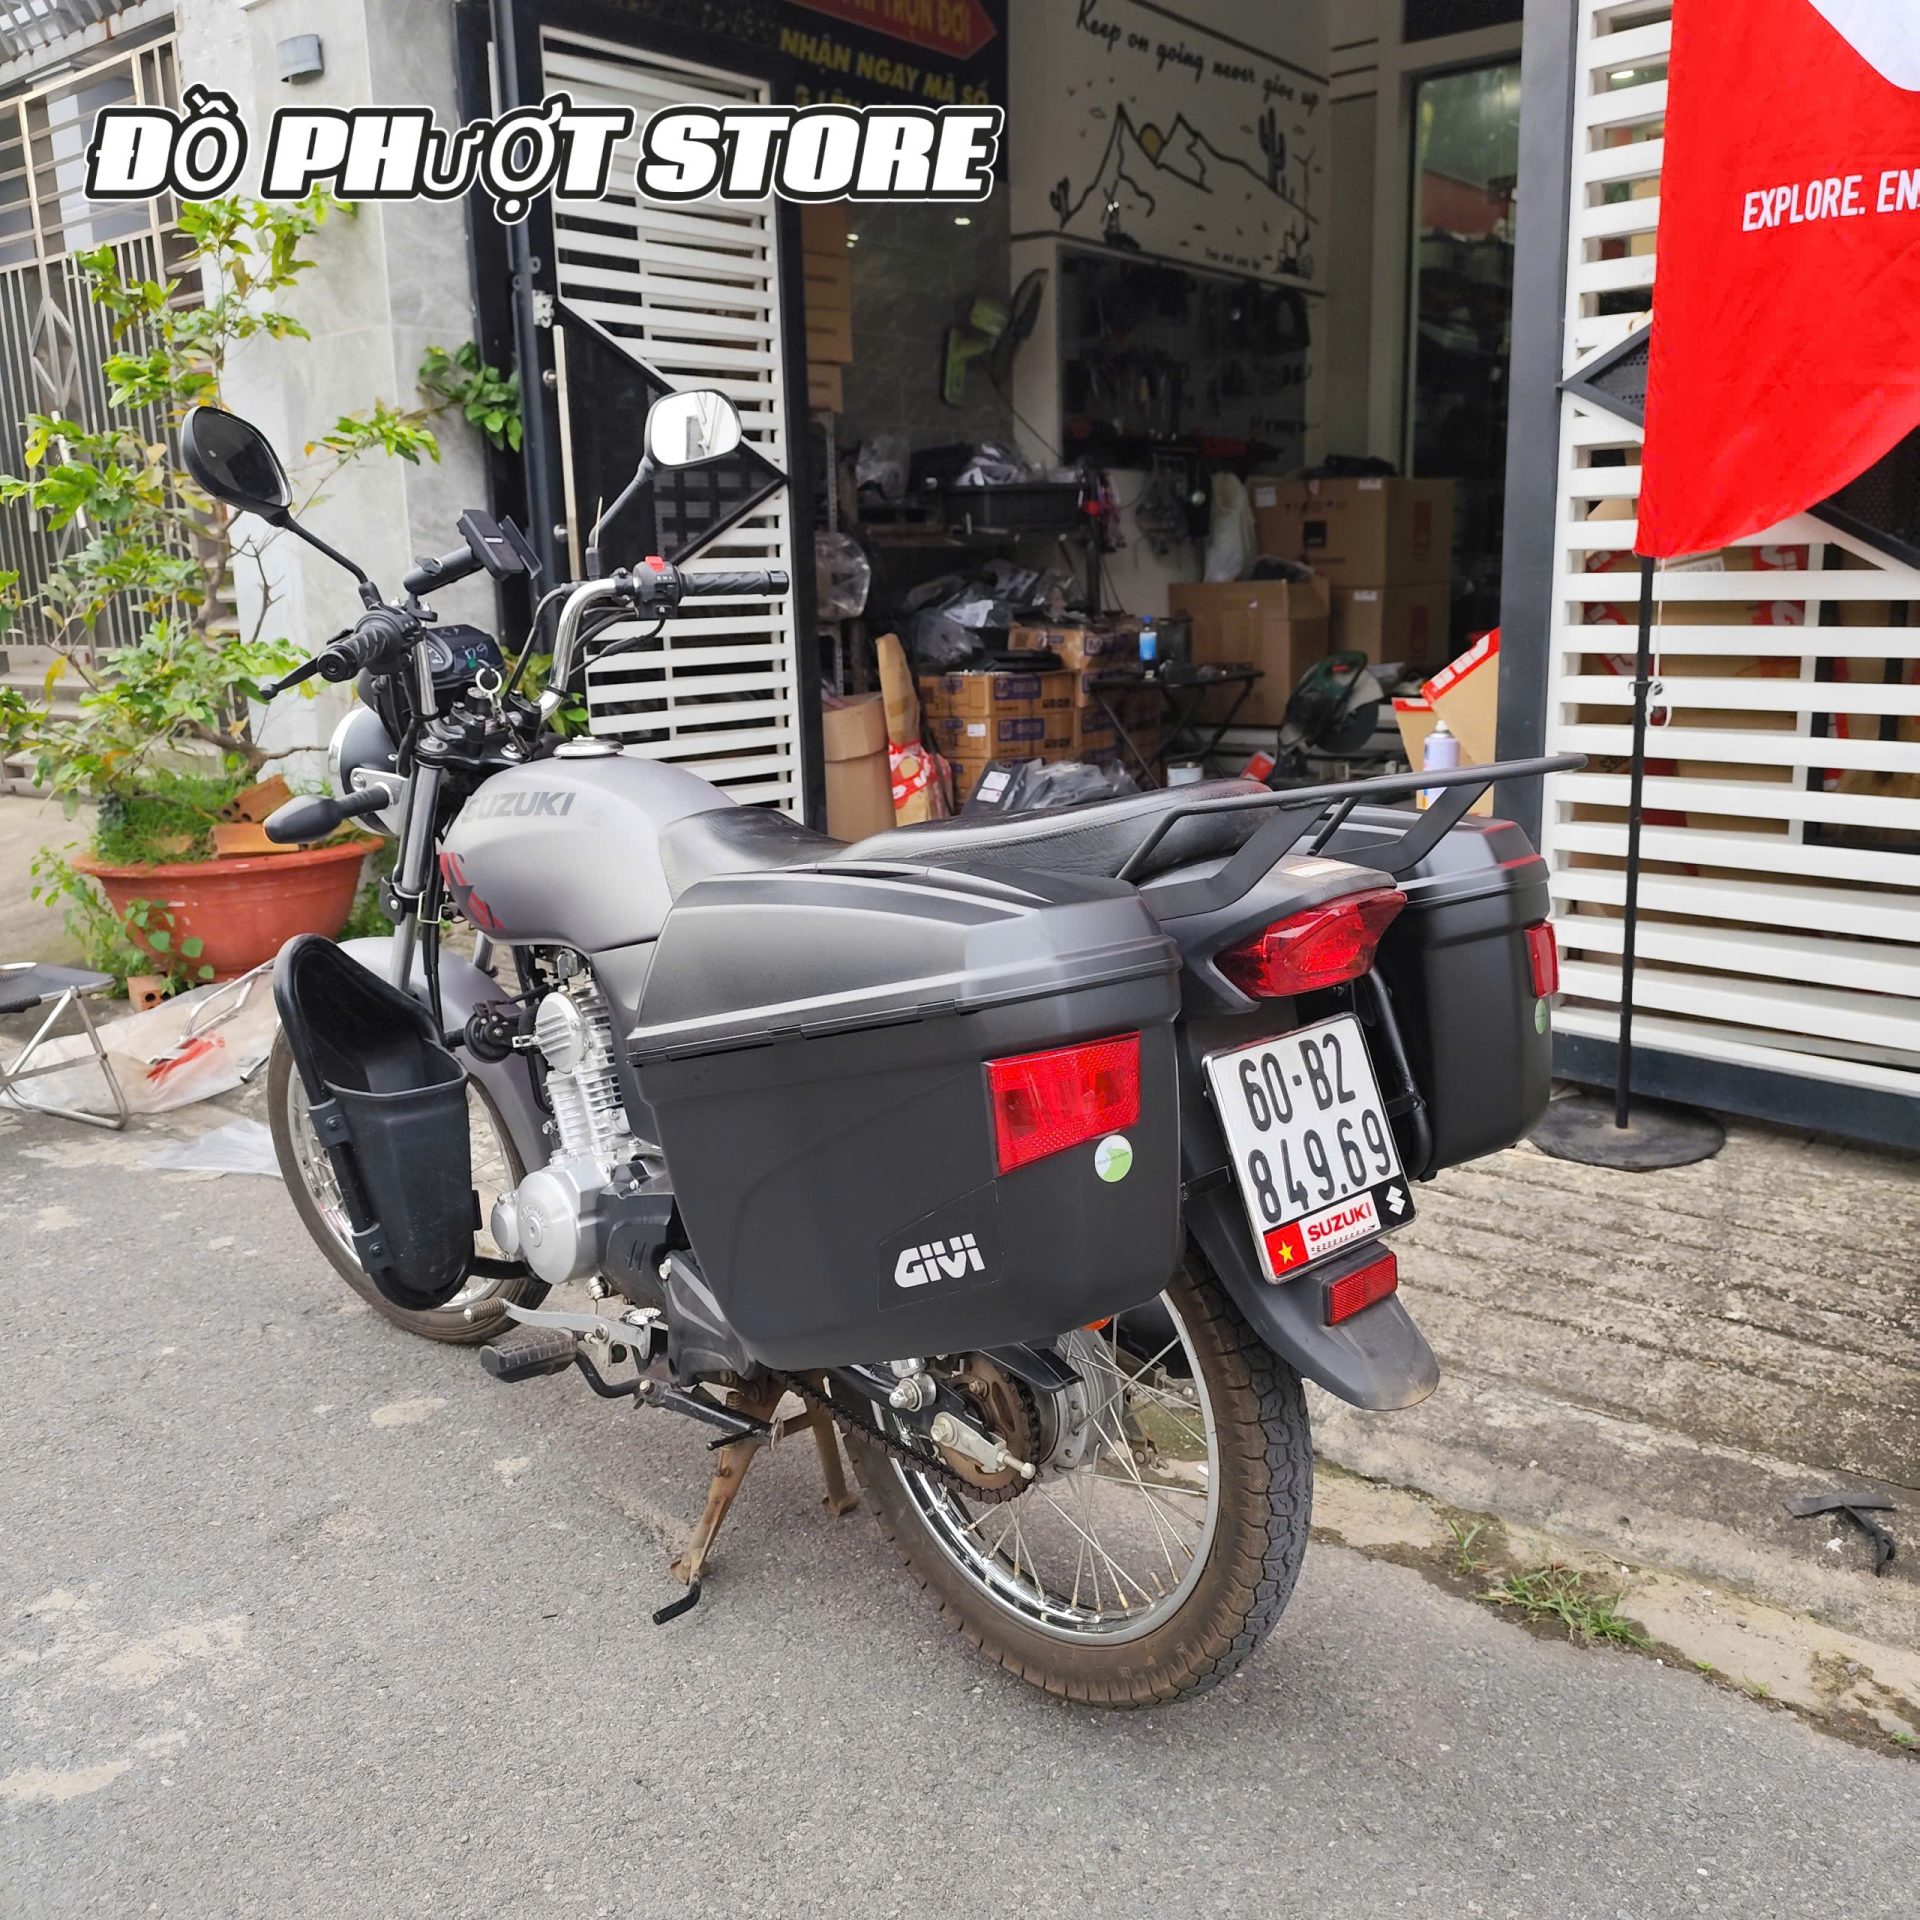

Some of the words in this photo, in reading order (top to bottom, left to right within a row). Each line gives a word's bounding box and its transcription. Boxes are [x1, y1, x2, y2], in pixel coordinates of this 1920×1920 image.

[779, 29, 851, 74] NHẬN
[856, 53, 919, 93] NGAY
[1076, 0, 1121, 52] Keep
[1127, 33, 1149, 52] on
[1156, 42, 1204, 83] going
[1212, 60, 1255, 84] never
[1263, 74, 1294, 103] give
[1301, 92, 1319, 117] up
[1742, 175, 1866, 232] EXPLORE.
[1876, 168, 1920, 213] EN
[462, 792, 576, 822] SUZUKI
[1238, 1033, 1356, 1132] 60-B2
[1248, 1109, 1391, 1223] 849.69
[1307, 1202, 1372, 1242] SUZUKI
